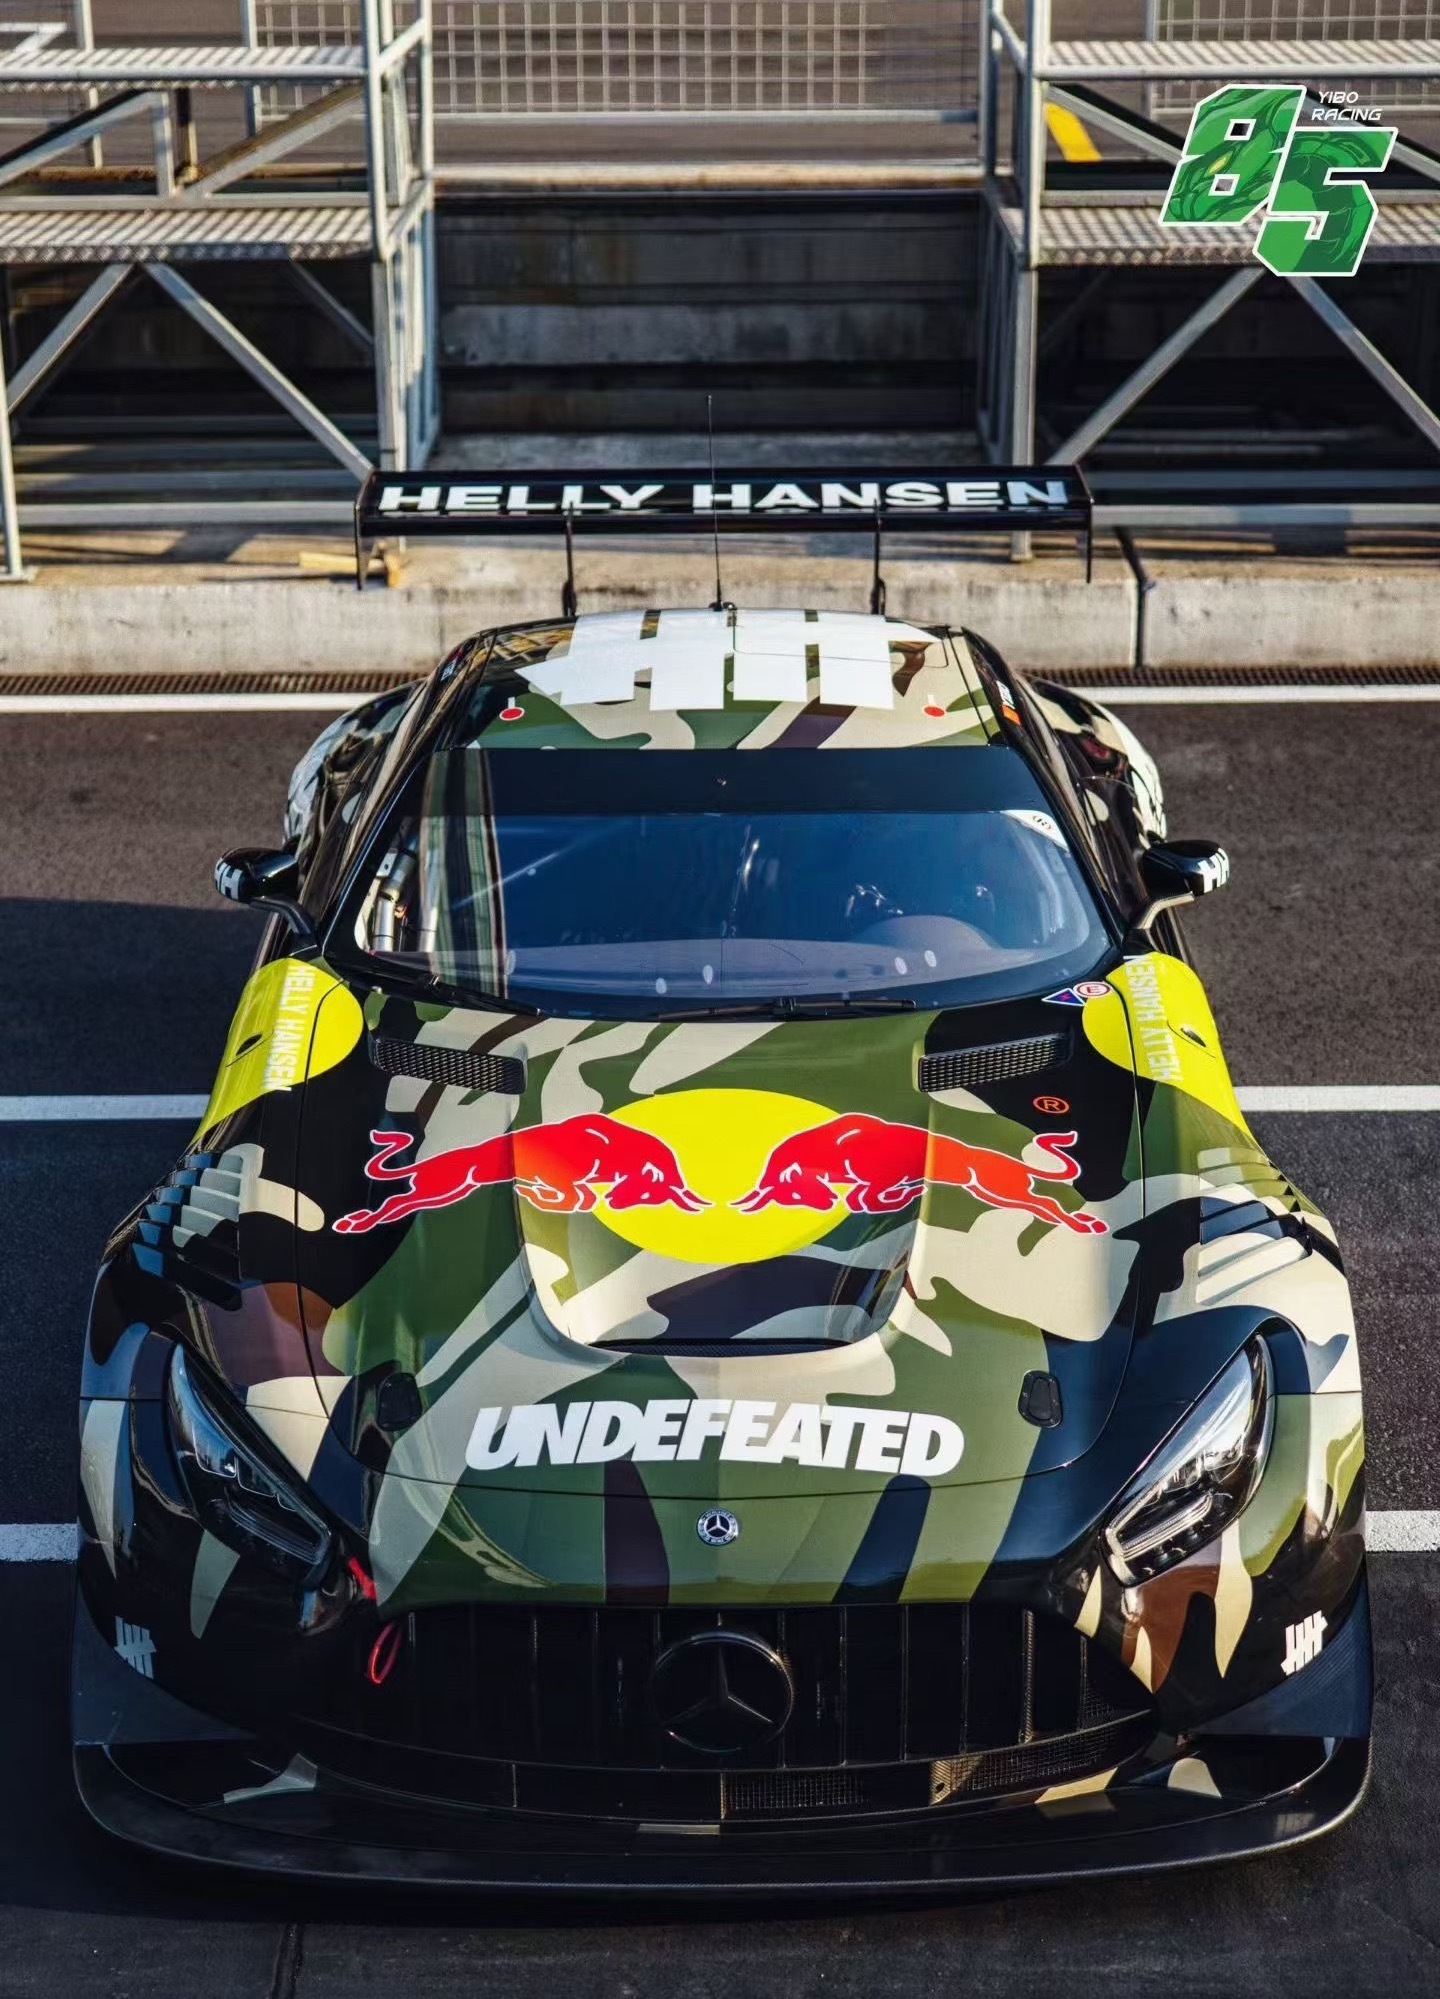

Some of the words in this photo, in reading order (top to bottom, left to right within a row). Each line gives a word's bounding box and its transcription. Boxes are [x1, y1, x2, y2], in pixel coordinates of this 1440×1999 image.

[378, 485, 665, 511] HELLY
[692, 481, 1069, 509] HANSEN
[279, 965, 315, 1014] HELLY
[1123, 955, 1168, 1022] HANSEN
[262, 1017, 303, 1091] HANSEN
[1141, 1027, 1183, 1081] HELLY
[465, 1399, 965, 1477] UNDEFEATED
